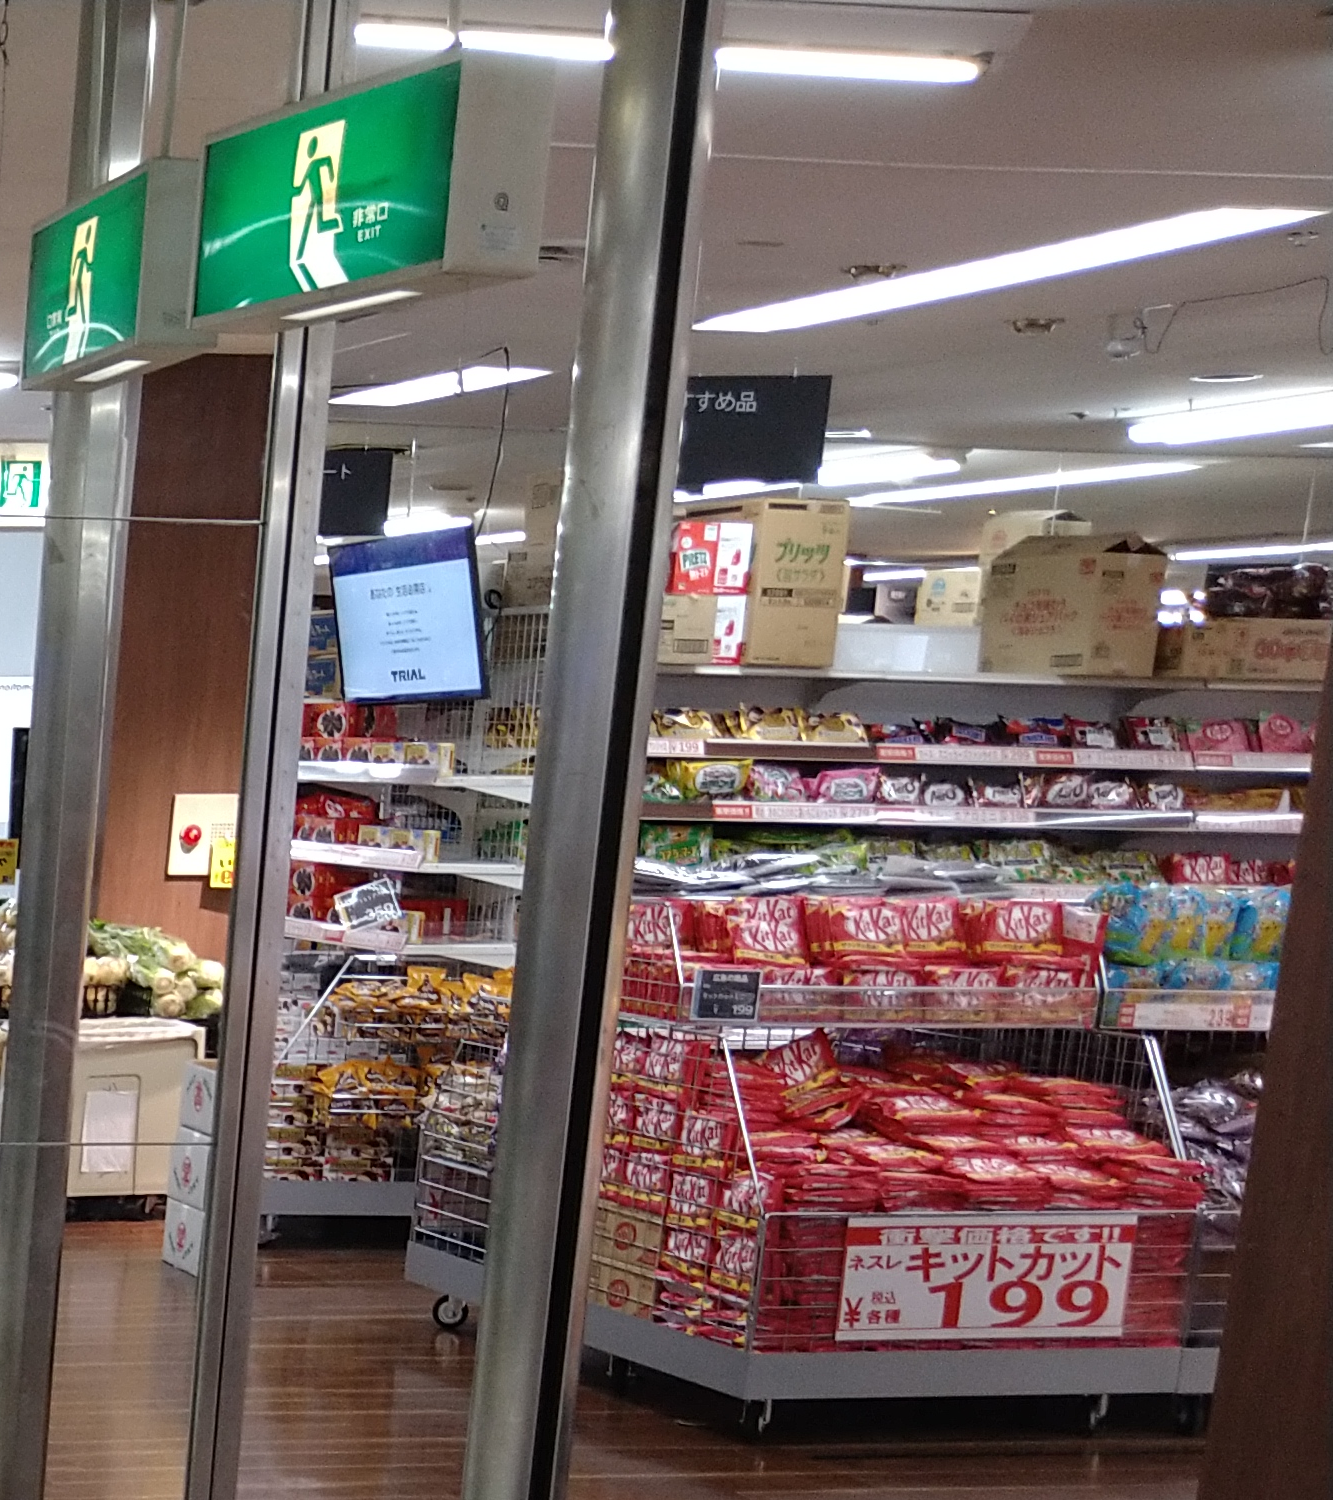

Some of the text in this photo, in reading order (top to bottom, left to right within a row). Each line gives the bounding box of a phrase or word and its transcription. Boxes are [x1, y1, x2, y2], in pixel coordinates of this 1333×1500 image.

[351, 202, 390, 229] 非常口
[356, 223, 382, 243] EXIT
[390, 668, 426, 683] TRIAL
[854, 905, 899, 941] KitKat
[904, 902, 952, 941] KitKat
[1002, 904, 1050, 942] KitKat
[732, 1004, 753, 1016] 199
[879, 1226, 1121, 1246] 衝撃価格です!!
[848, 1244, 1123, 1283] ネスレ キットカット
[865, 1309, 901, 1325] 各種
[928, 1279, 1109, 1329] 199
